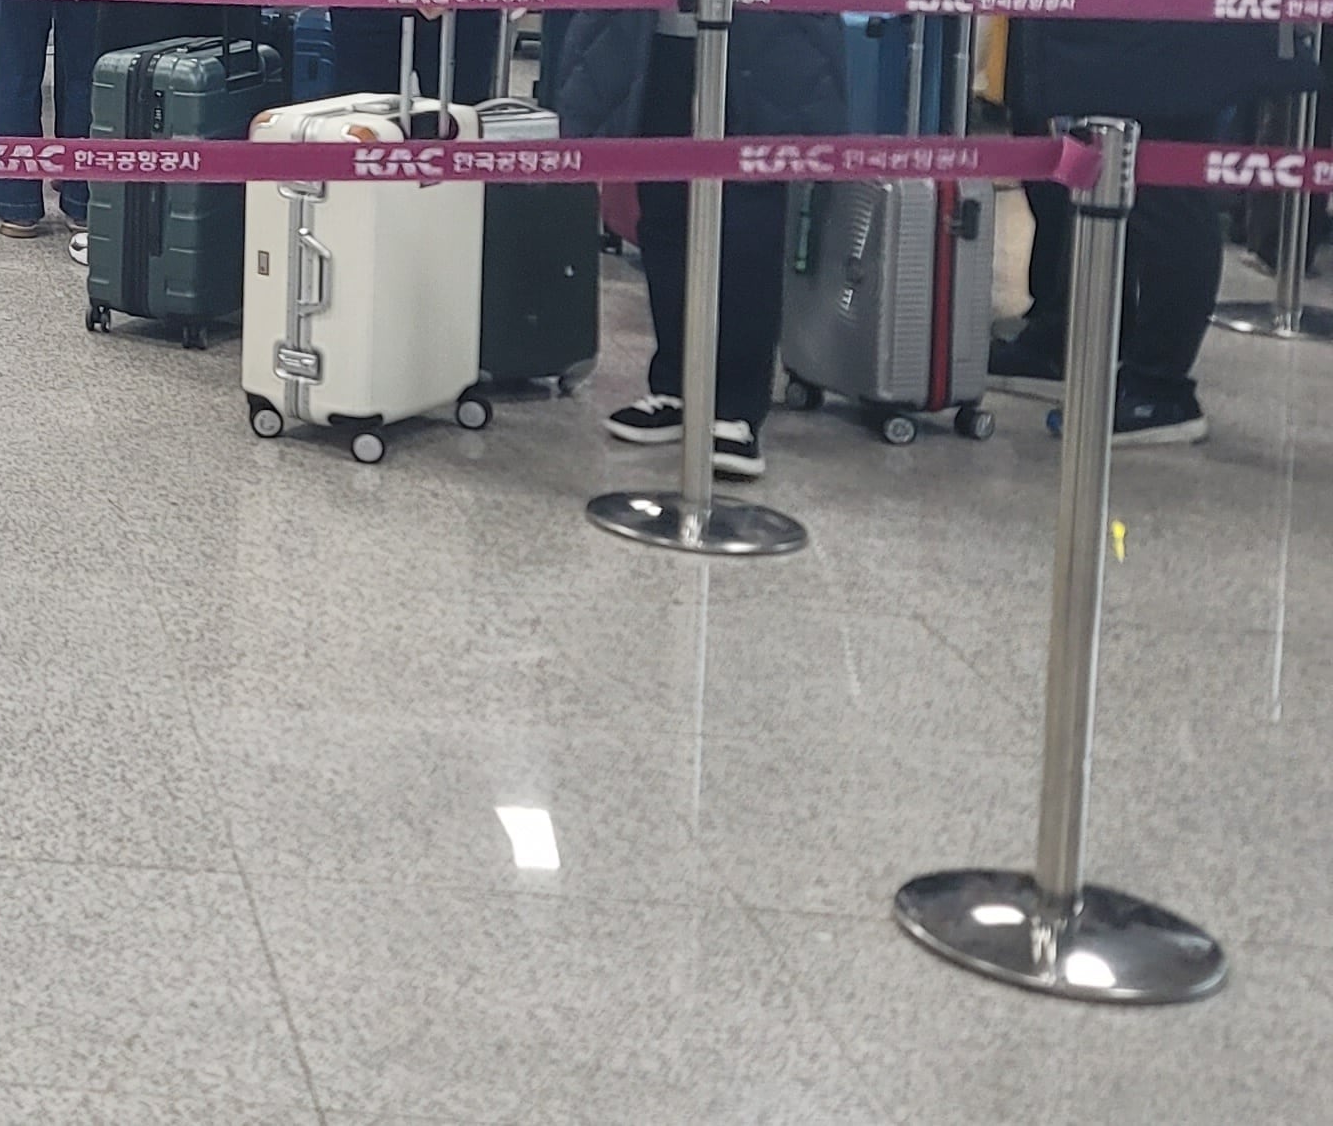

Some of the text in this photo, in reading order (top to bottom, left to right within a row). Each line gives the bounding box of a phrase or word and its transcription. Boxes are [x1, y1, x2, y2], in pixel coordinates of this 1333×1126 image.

[74, 149, 201, 172] 한국공항공사
[353, 147, 582, 176] KAC 한국공항공사
[738, 144, 834, 173] KAC
[1206, 150, 1306, 188] KAC
